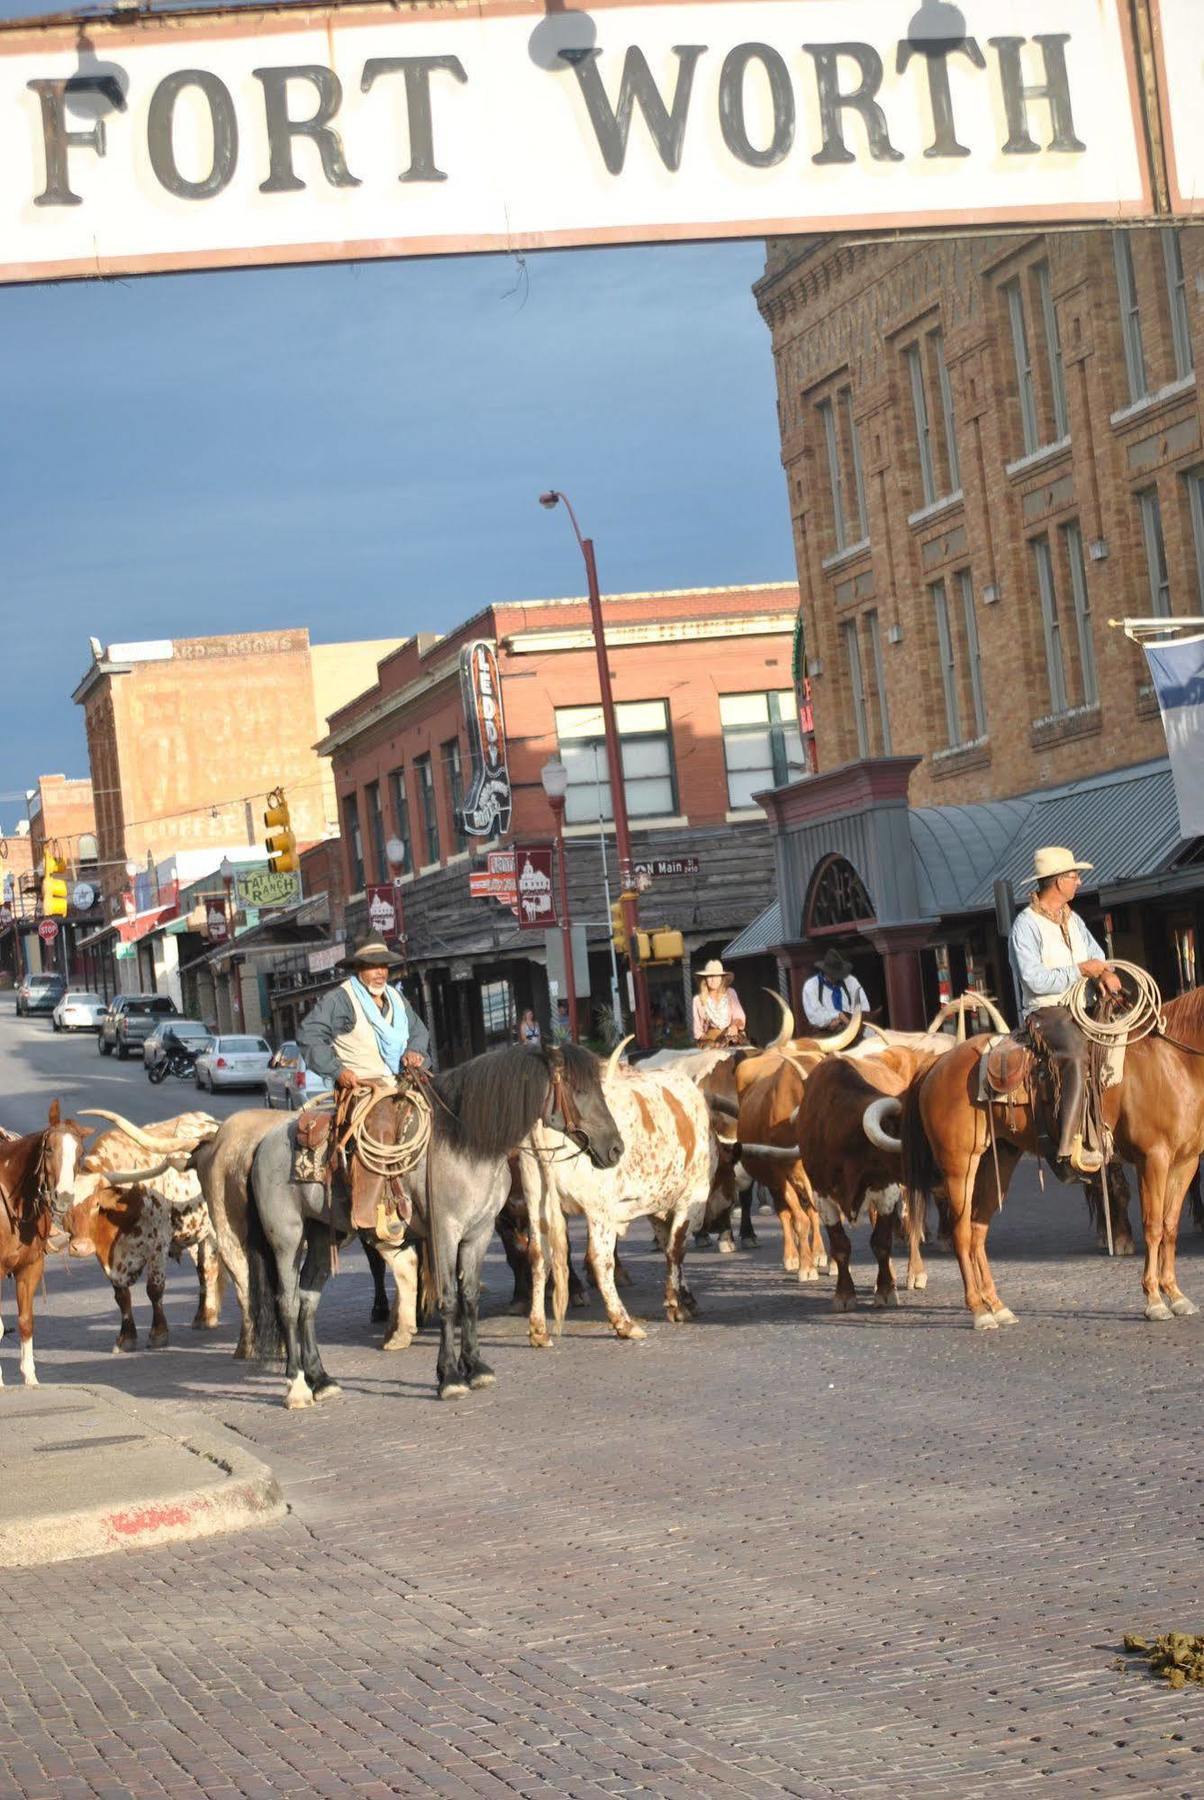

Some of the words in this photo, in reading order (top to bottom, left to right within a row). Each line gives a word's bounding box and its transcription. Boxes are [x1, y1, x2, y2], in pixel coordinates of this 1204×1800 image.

[26, 54, 469, 207] FORT
[557, 33, 1087, 176] WORTH
[477, 649, 498, 767] LEDDY
[646, 863, 654, 874] N
[658, 861, 682, 874] Main
[239, 873, 284, 895] TATTOO
[252, 879, 294, 902] RANCH
[40, 925, 56, 934] STOP
